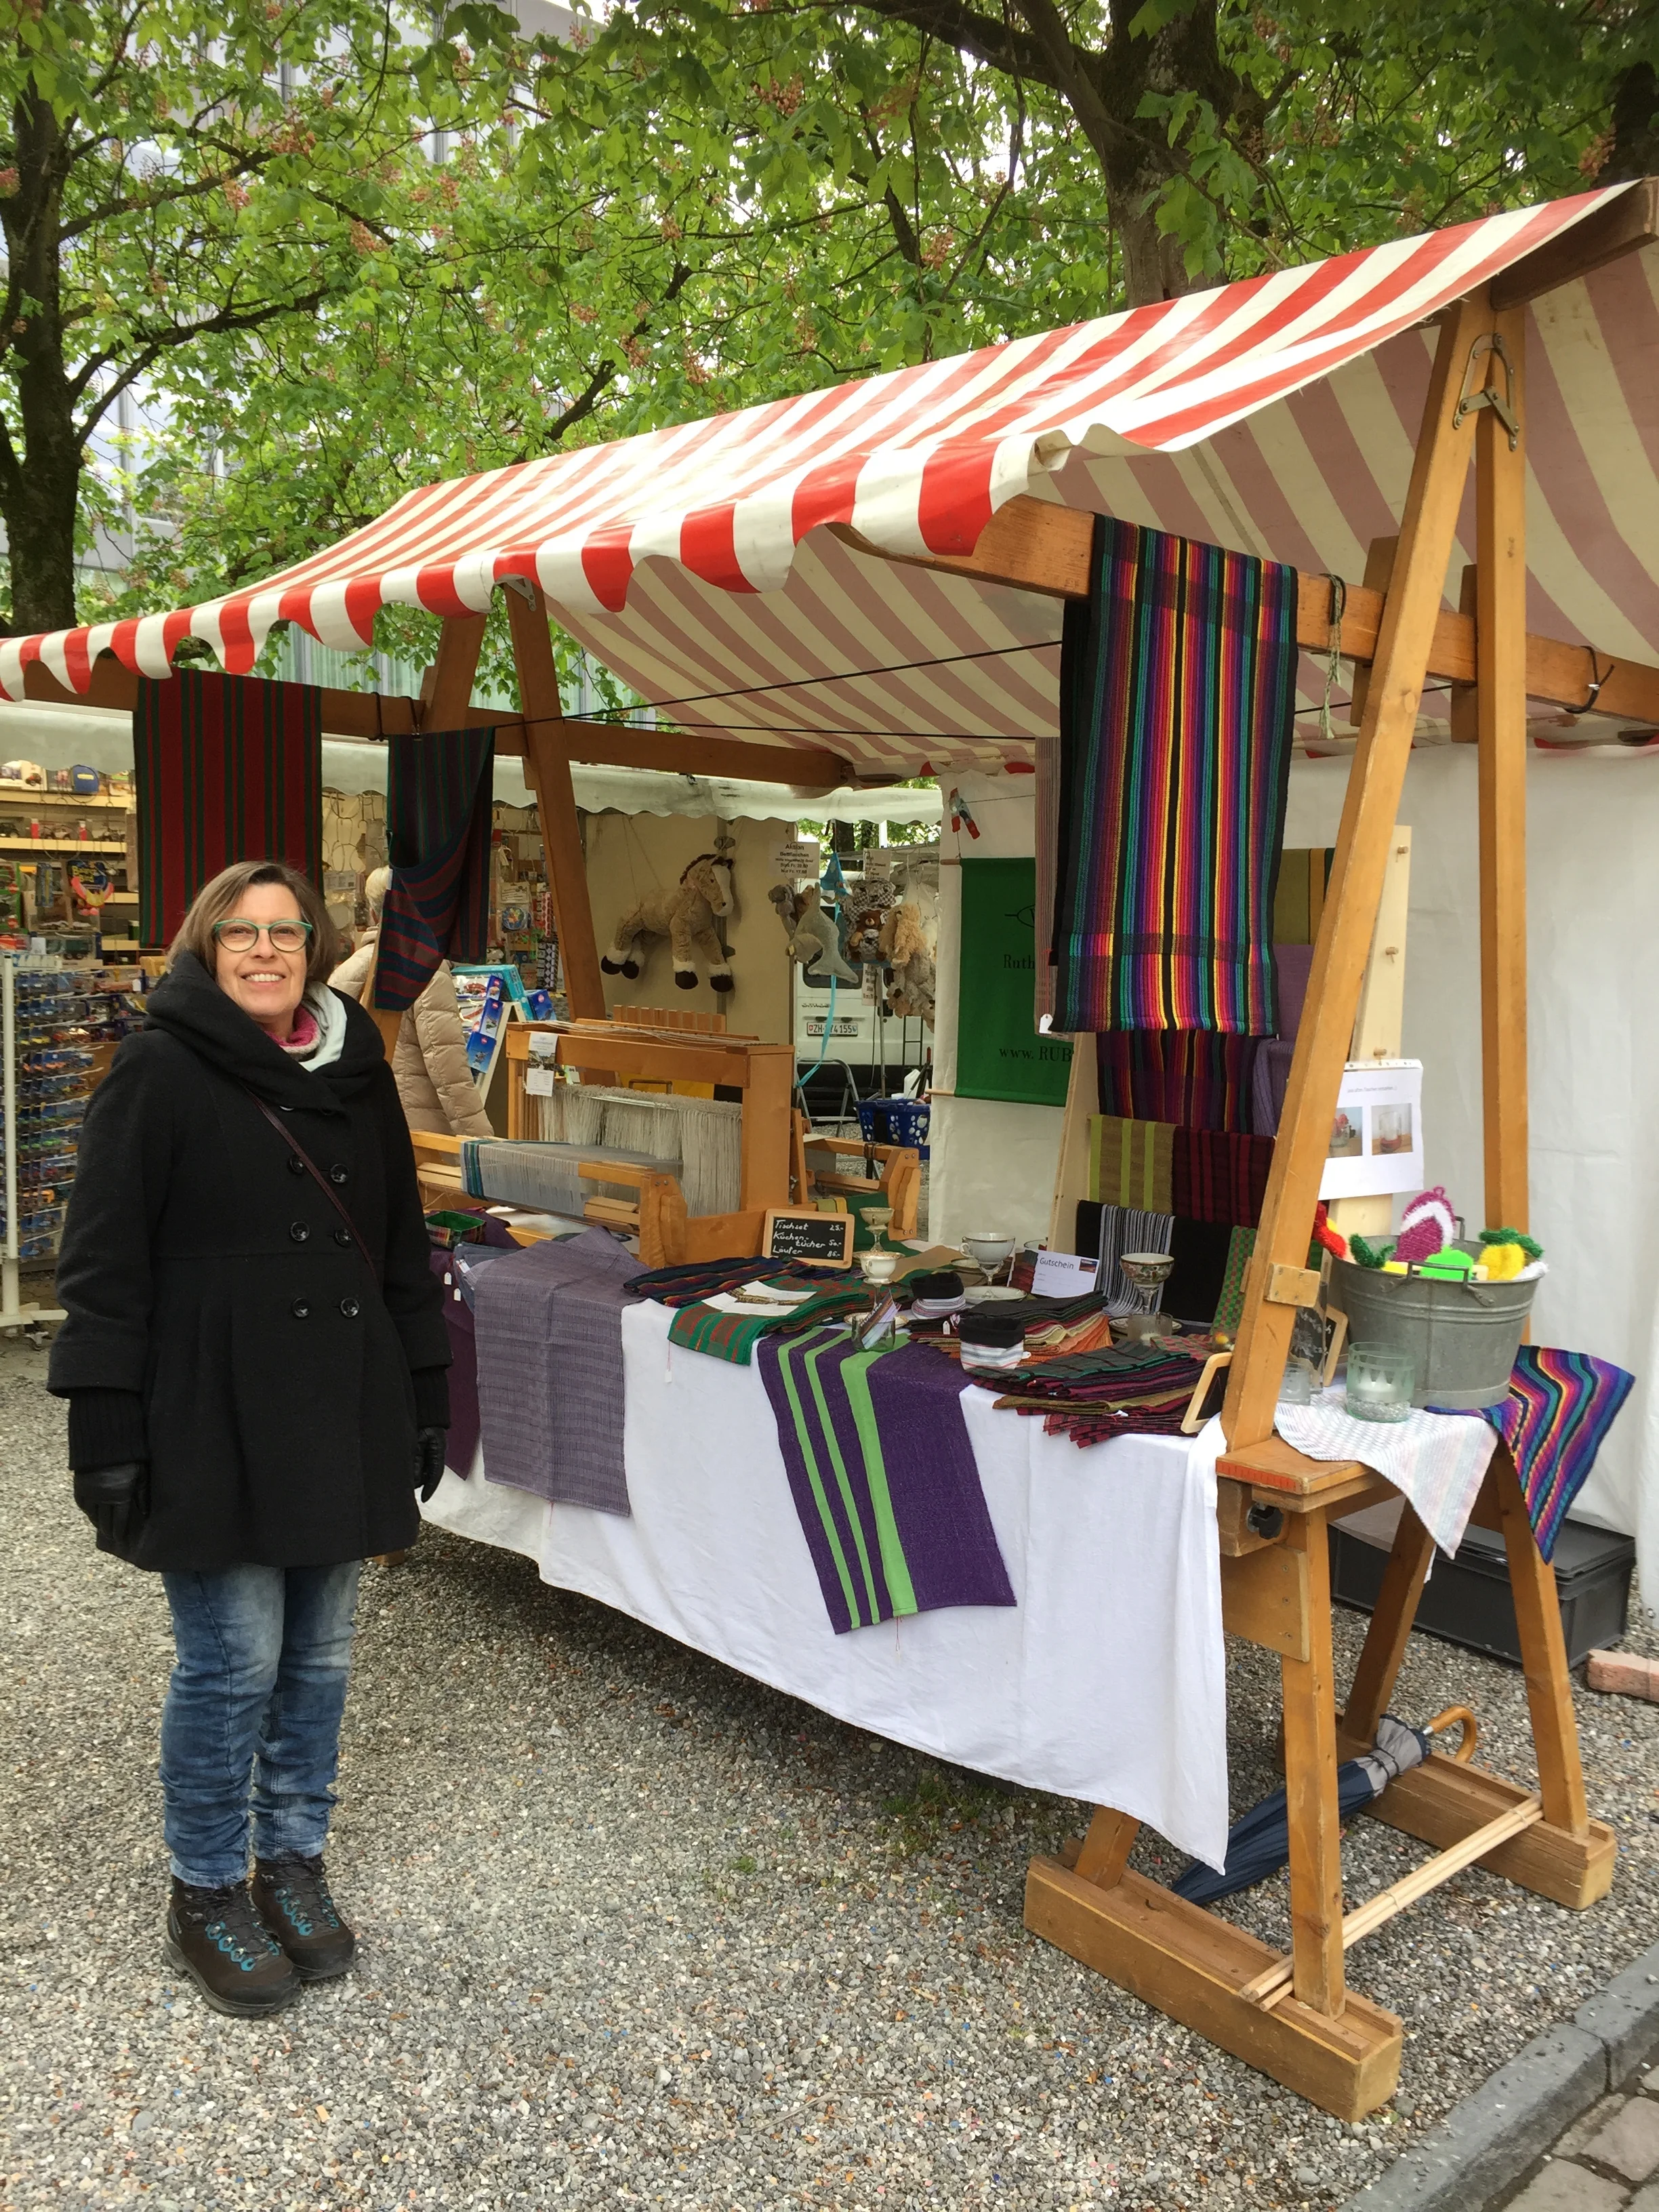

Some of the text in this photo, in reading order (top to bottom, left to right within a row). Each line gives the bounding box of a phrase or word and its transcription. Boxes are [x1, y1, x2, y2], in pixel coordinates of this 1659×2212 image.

[1003, 954, 1035, 969] Ruth
[775, 1219, 808, 1230] Tischset
[1040, 1257, 1074, 1269] Gutschein
